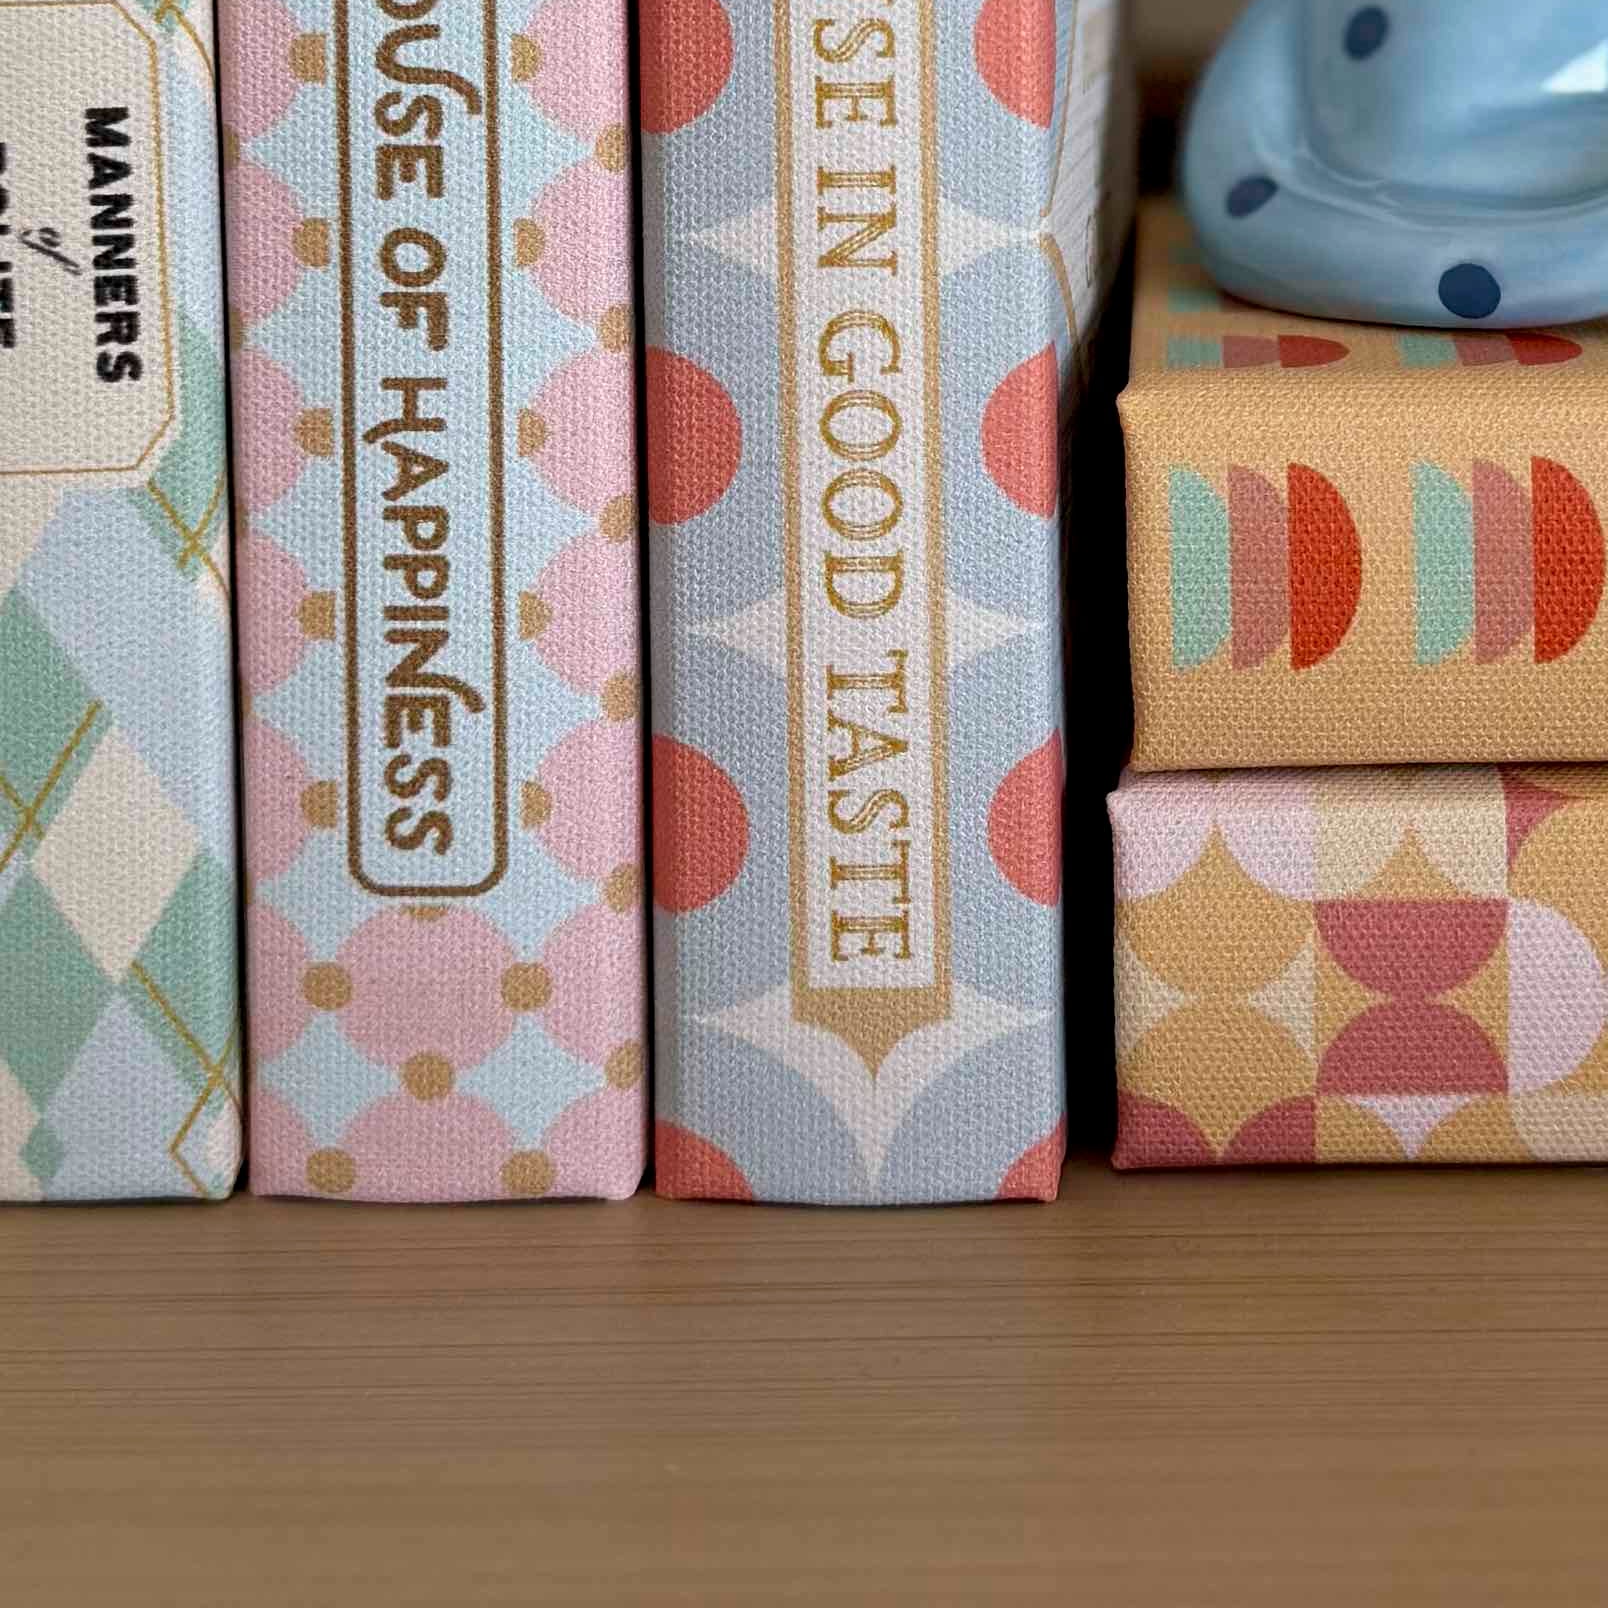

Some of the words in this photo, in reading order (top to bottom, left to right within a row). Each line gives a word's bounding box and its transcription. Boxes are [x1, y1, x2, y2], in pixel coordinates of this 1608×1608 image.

[19, 227, 82, 275] of
[85, 106, 142, 383] MANNERS
[379, 228, 448, 352] OF
[815, 166, 898, 274] IN
[818, 309, 903, 616] GOOD
[364, 376, 484, 853] HAPPINESS
[826, 648, 911, 963] TASTE
